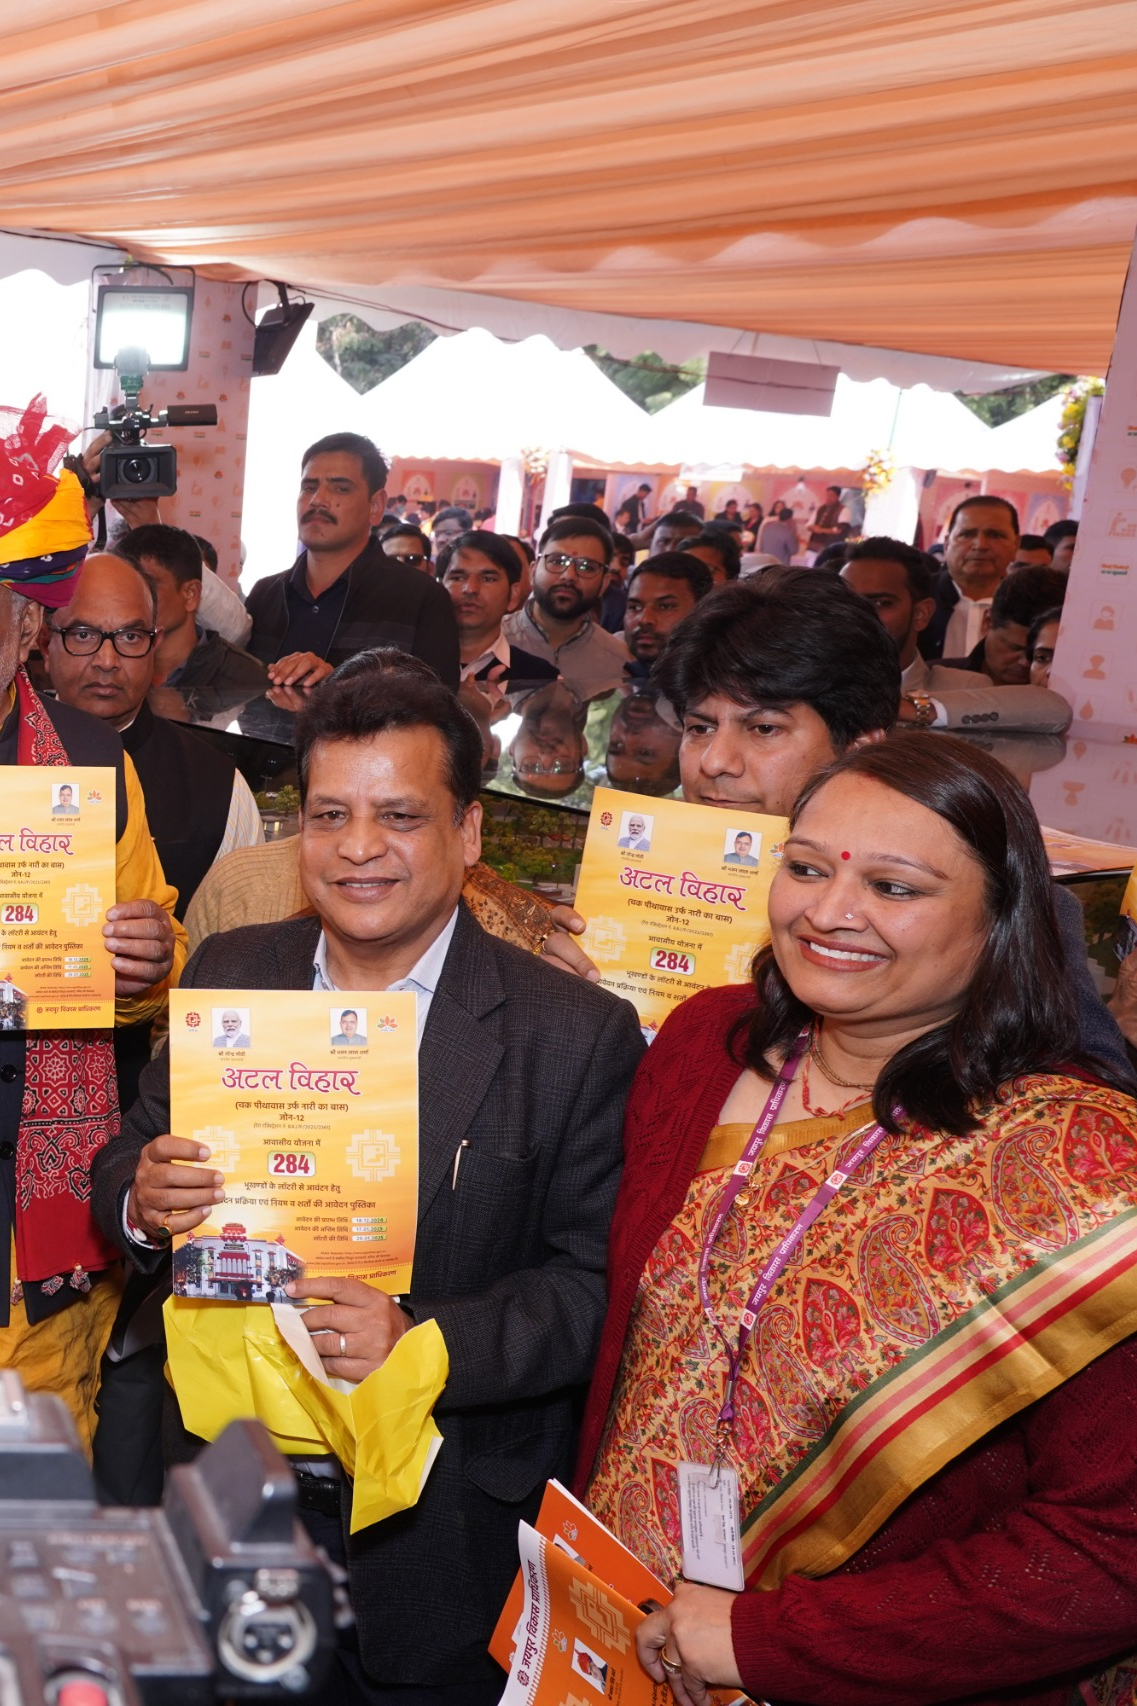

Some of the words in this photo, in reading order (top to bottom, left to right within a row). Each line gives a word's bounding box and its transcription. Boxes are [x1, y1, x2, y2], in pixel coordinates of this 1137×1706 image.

[19, 827, 75, 856] विहार
[29, 860, 39, 868] नारी
[11, 870, 31, 878] जोन-12
[619, 866, 675, 896] अटल
[679, 871, 747, 911] विहार
[5, 905, 34, 922] 284
[666, 914, 690, 926] जोन-12
[688, 909, 701, 917] नारी
[703, 912, 713, 920] का
[49, 929, 57, 938] हेतु
[648, 935, 675, 945] आवासीय
[677, 940, 695, 949] योजना
[654, 949, 689, 972] 284
[60, 1004, 77, 1012] विकास
[78, 1004, 101, 1012] प्राधिकरण
[221, 1066, 283, 1090] अटल
[289, 1060, 362, 1096] विहार
[287, 1100, 299, 1111] उर्फ
[301, 1101, 316, 1111] नारी
[317, 1103, 328, 1111] का
[279, 1112, 305, 1122] जोन-12
[748, 1137, 763, 1156] जयपुर
[757, 1113, 774, 1135] विकास
[263, 1138, 292, 1147] आवासीय
[293, 1138, 315, 1147] योजना
[273, 1153, 310, 1174] 284
[845, 1149, 865, 1168] जयपुर
[244, 1181, 267, 1191] भूखण्डों
[268, 1181, 276, 1190] के
[277, 1180, 297, 1191] लॉटरी
[299, 1183, 305, 1191] से
[306, 1183, 328, 1192] आवंटन
[330, 1183, 341, 1194] हेतु
[235, 1196, 257, 1206] प्रक्रिया
[258, 1198, 269, 1206] एवं
[270, 1198, 288, 1207] नियम
[297, 1199, 311, 1208] शर्तों
[313, 1200, 323, 1208] की
[325, 1200, 348, 1208] आवेदन
[350, 1200, 376, 1210] पुस्तिका
[751, 1283, 767, 1306] जयपुर
[762, 1256, 781, 1281] विकास
[779, 1223, 803, 1255] प्राधिकरण
[527, 1559, 540, 1604] प्राधिकरण
[526, 1602, 540, 1638] विकास
[522, 1636, 537, 1669] जयपुर
